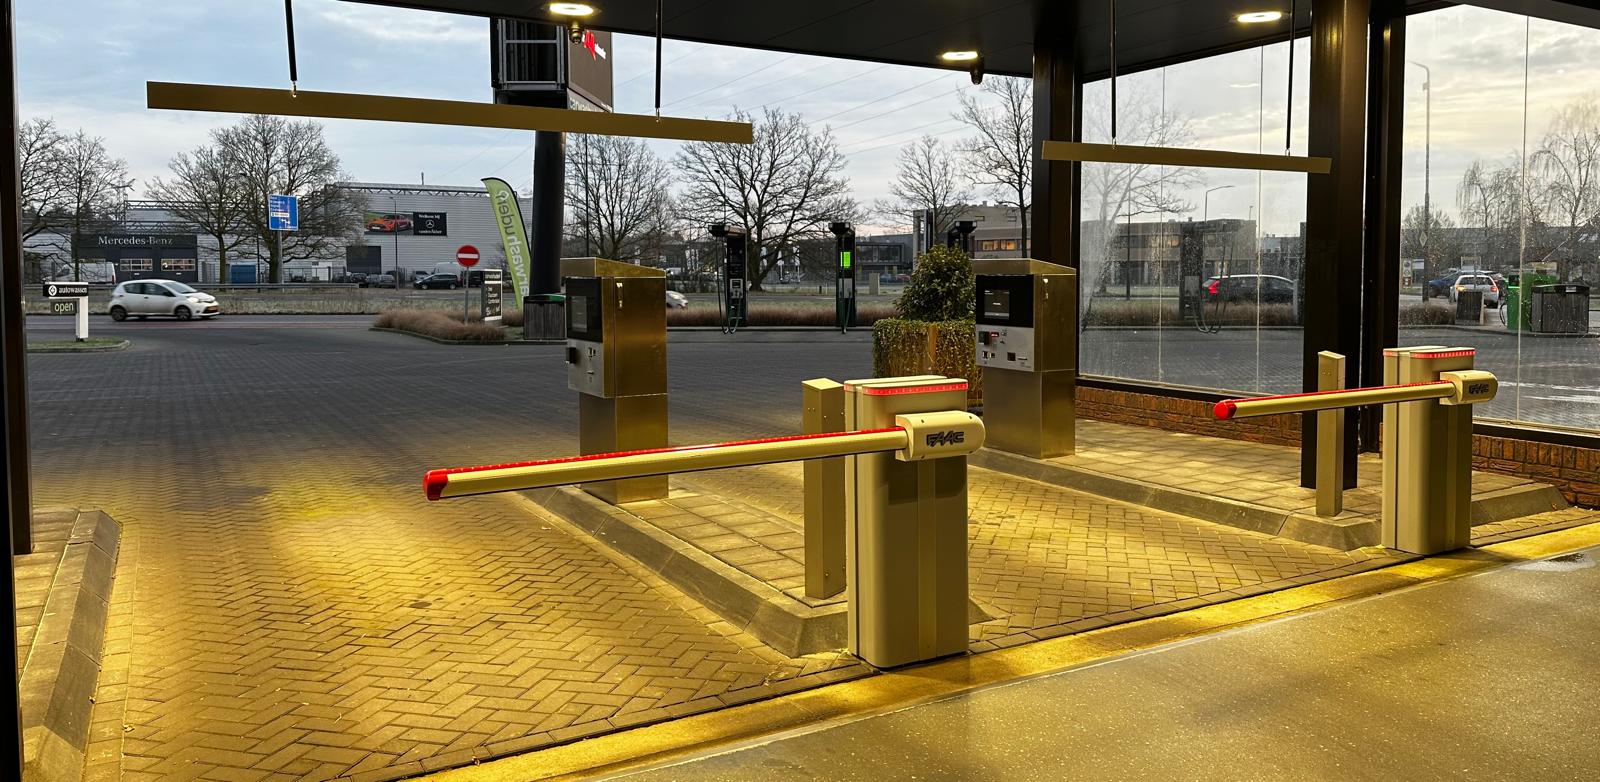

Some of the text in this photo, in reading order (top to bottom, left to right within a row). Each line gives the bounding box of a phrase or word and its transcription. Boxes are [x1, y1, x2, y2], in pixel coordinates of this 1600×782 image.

[98, 236, 174, 245] Mercedes-Benz
[54, 303, 74, 315] open
[926, 430, 965, 447] FAAC
